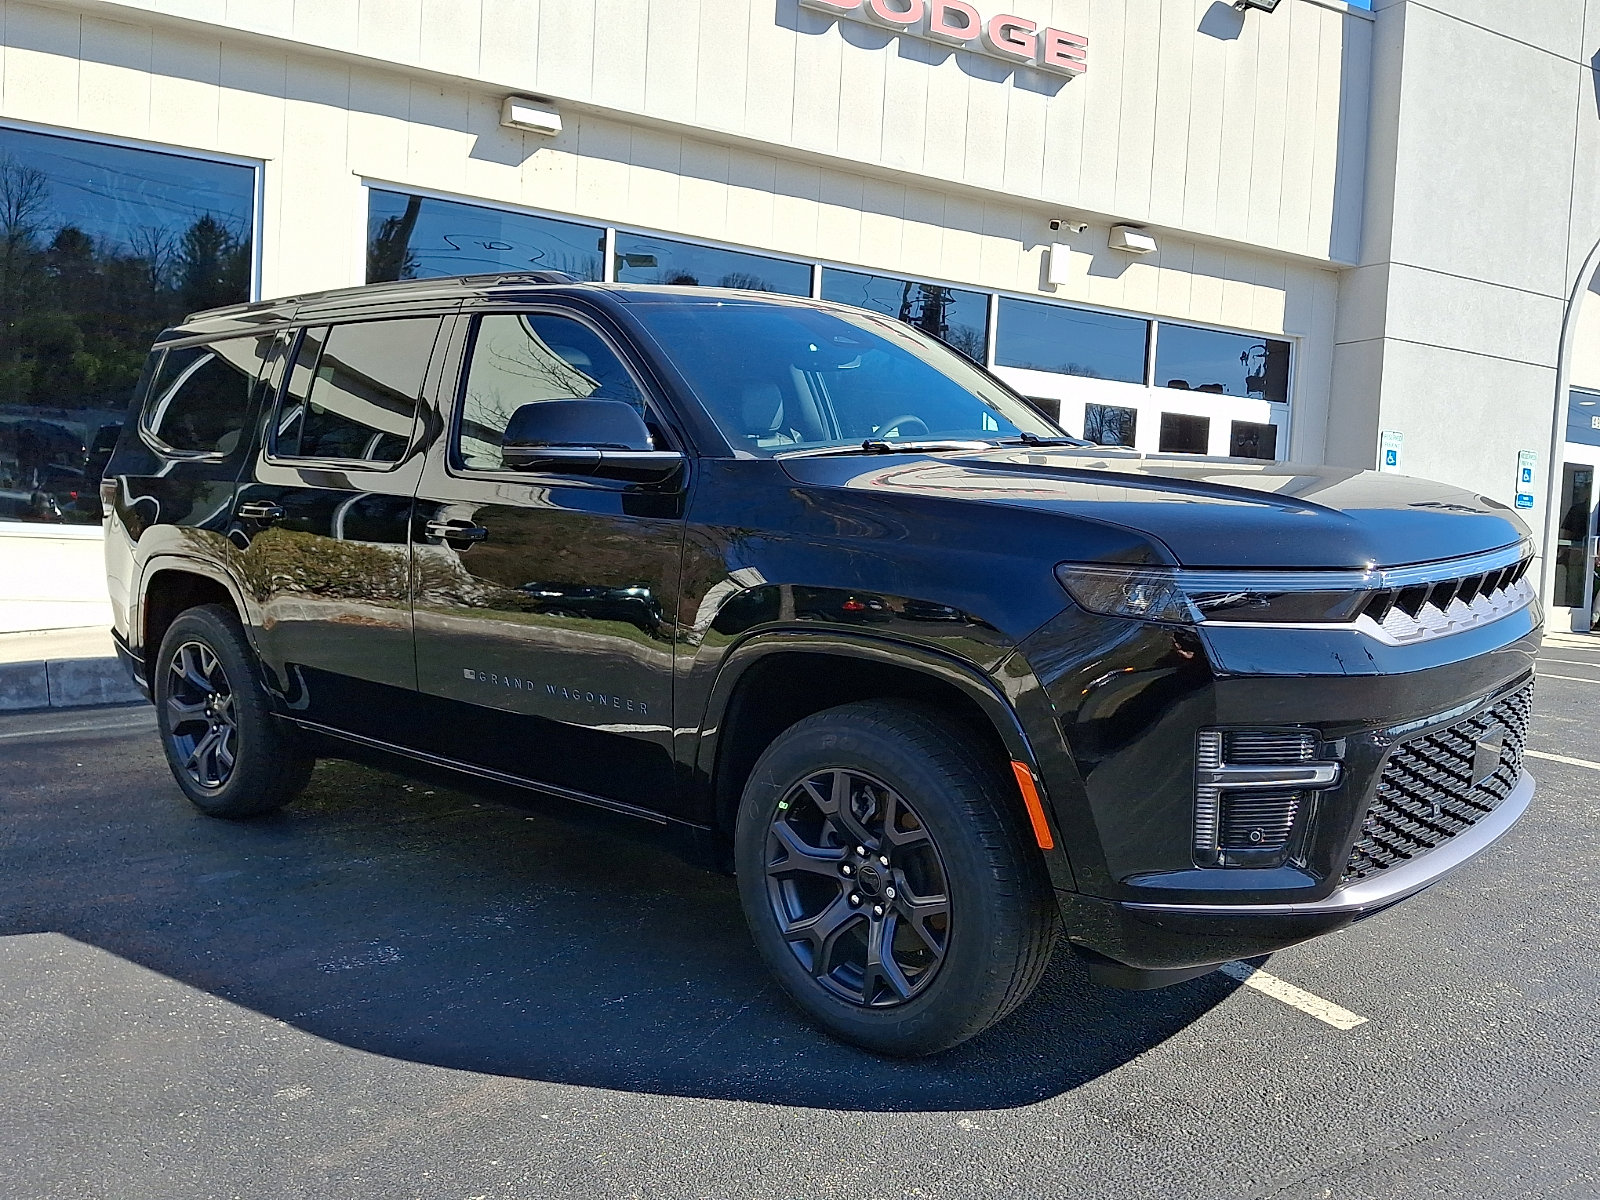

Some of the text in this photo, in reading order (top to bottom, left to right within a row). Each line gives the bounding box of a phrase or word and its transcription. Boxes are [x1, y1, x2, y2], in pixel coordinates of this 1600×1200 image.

[799, 0, 1089, 74] ODGE
[479, 671, 648, 715] GRAND WAGONEER
